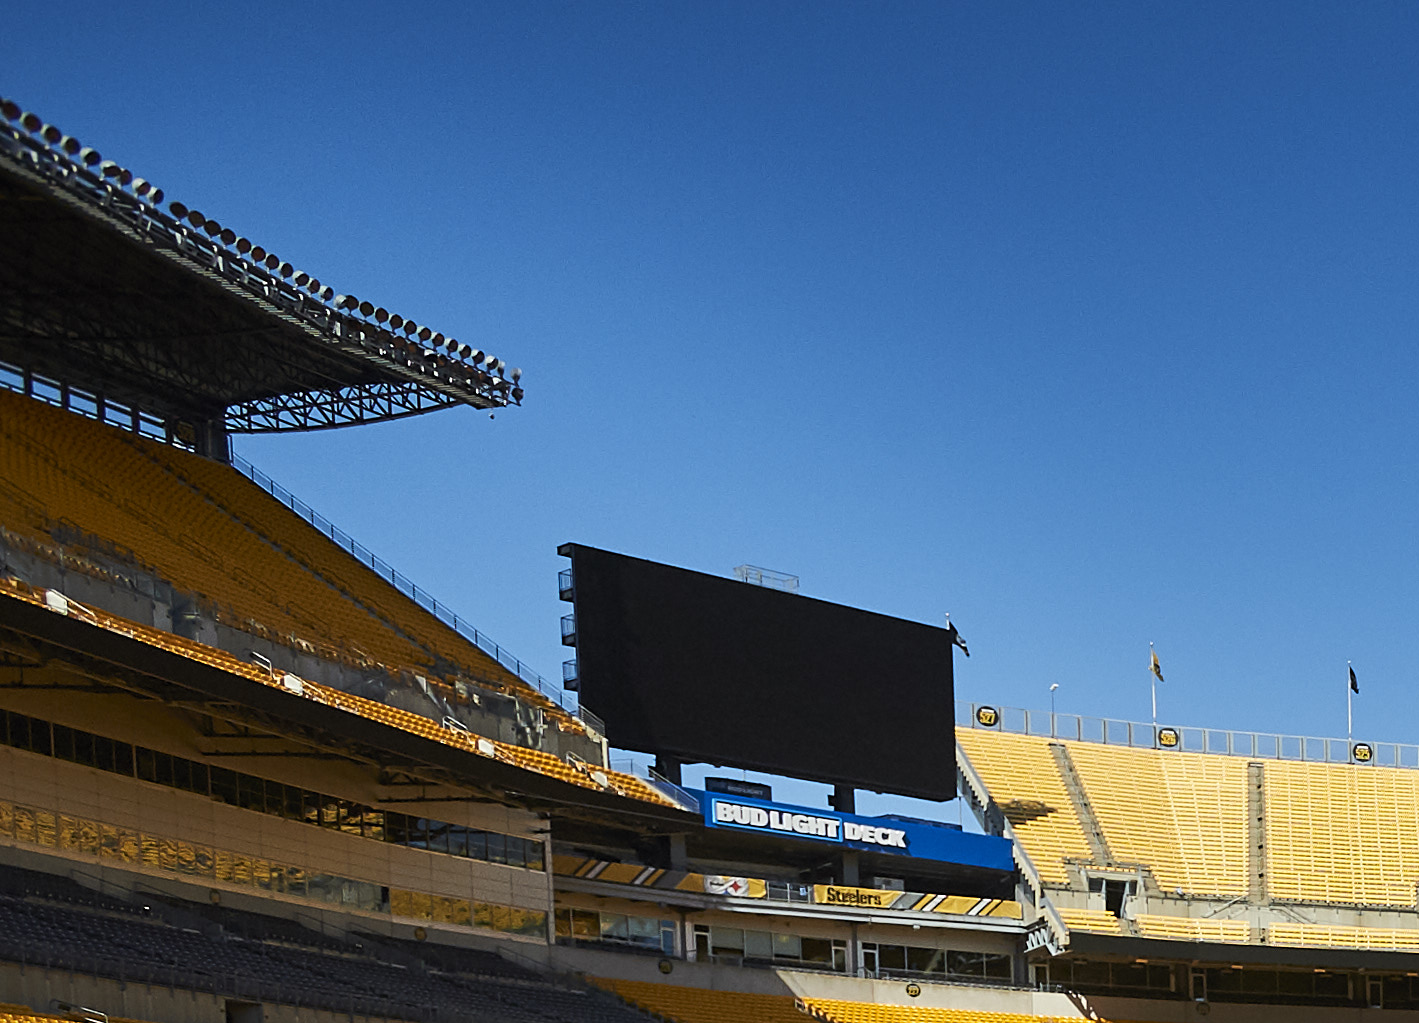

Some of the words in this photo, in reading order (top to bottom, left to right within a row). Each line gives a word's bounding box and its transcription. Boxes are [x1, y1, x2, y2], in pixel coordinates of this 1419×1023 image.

[979, 711, 995, 724] 527
[715, 801, 768, 827] BUD
[769, 811, 840, 838] LIGHT
[844, 822, 907, 848] DECK
[827, 887, 881, 906] Steelers
